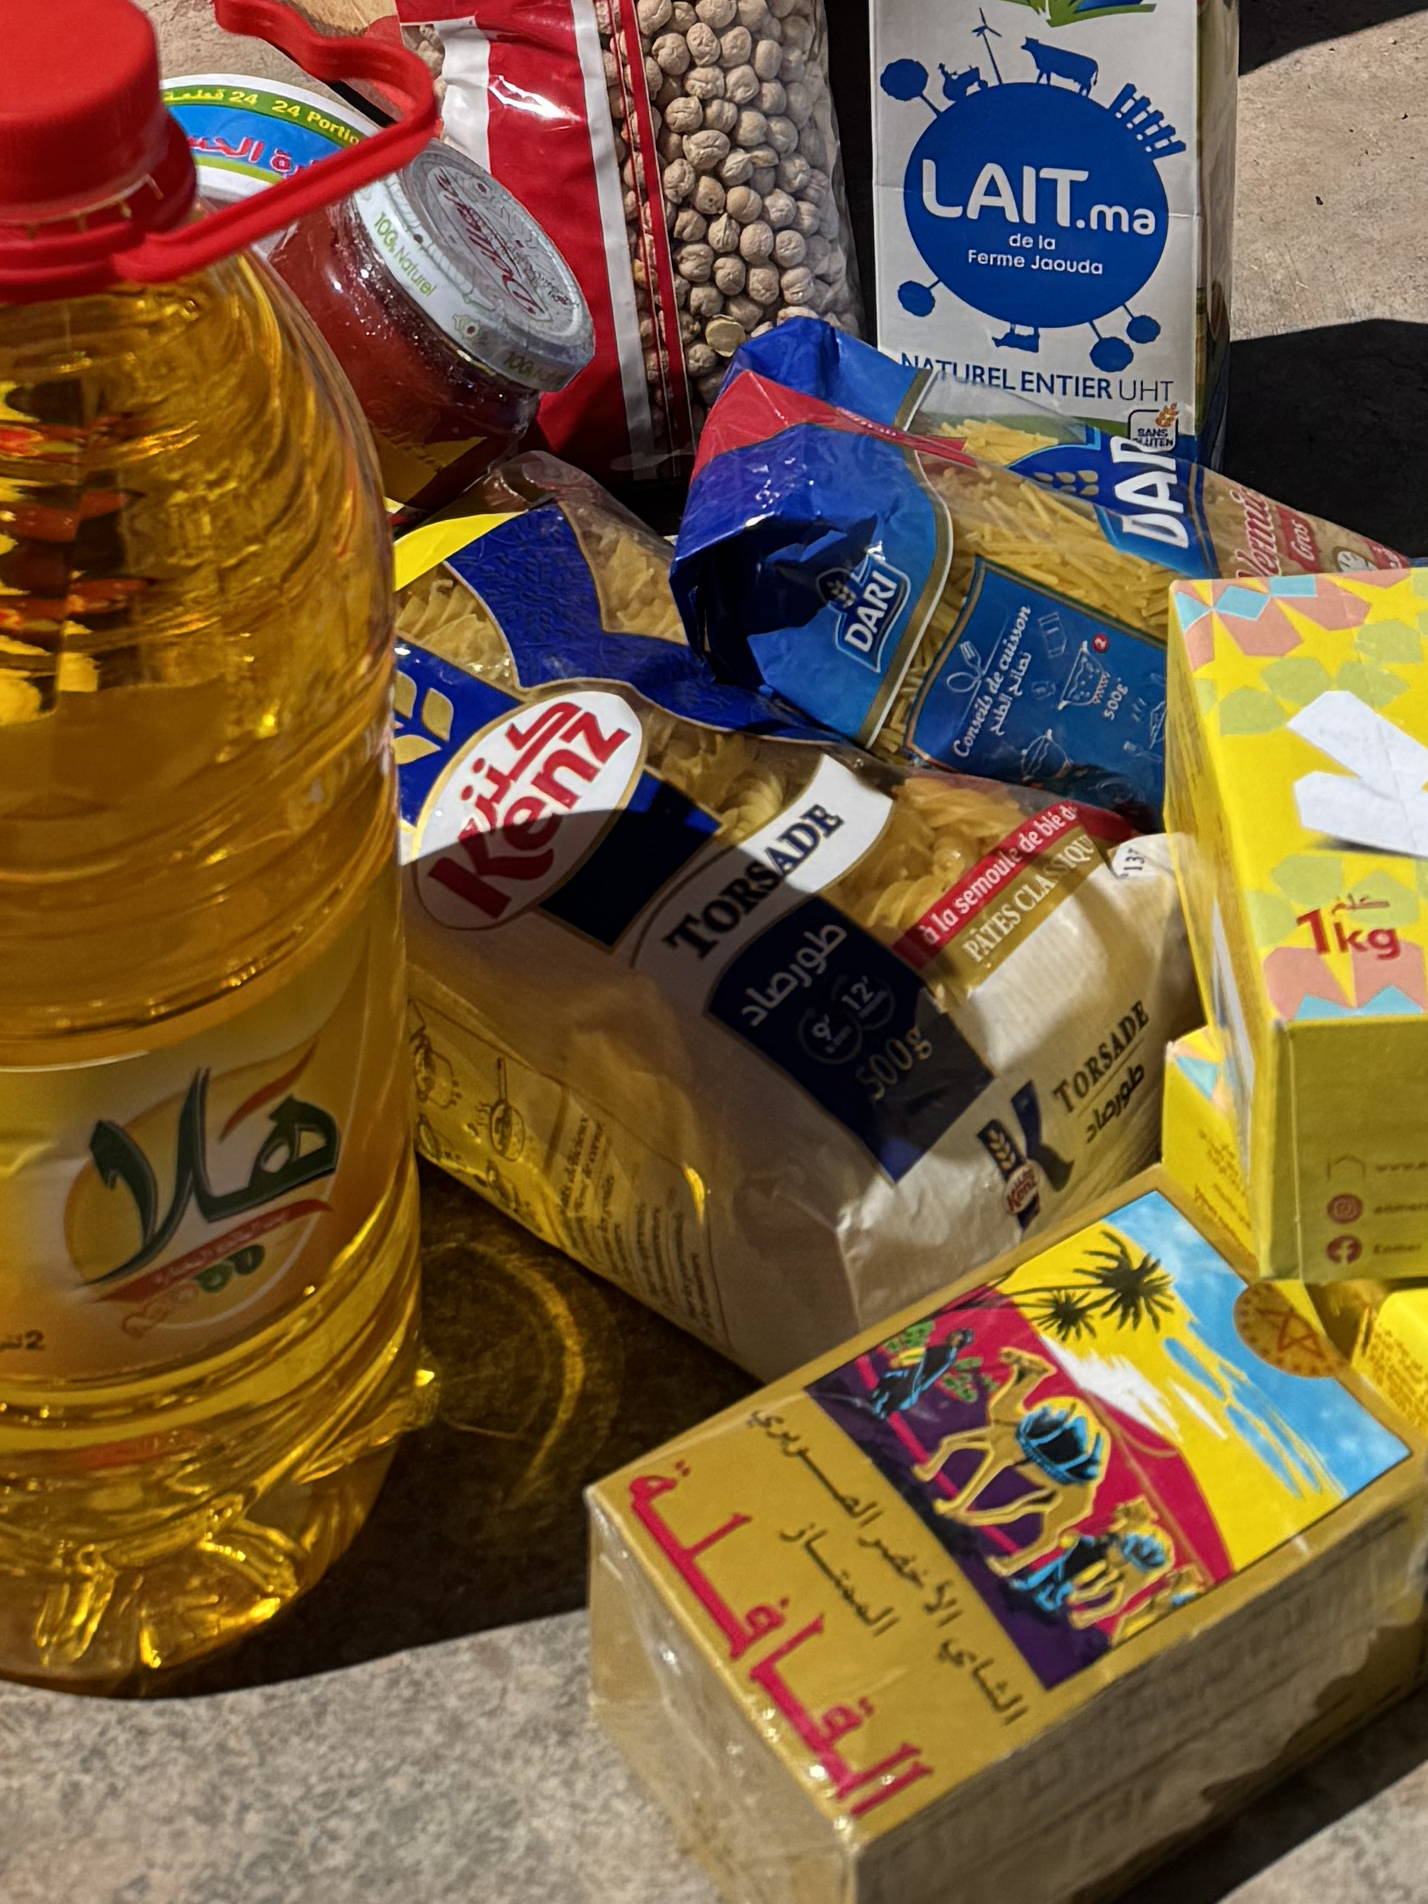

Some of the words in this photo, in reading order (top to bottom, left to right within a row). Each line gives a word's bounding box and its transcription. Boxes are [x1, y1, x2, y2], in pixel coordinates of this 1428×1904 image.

[229, 91, 258, 105] 24
[272, 100, 300, 117] 24
[307, 111, 360, 145] Portio
[922, 159, 1156, 235] LAIT.ma
[391, 246, 438, 298] Naturel
[968, 250, 1025, 269] Ferme
[1031, 253, 1104, 275] Jaouda
[1009, 234, 1033, 248] de
[1038, 235, 1056, 250] la
[1021, 371, 1112, 399] ENTIER
[1119, 379, 1174, 402] UHT
[1138, 428, 1168, 441] SANS
[1289, 519, 1315, 562] Gros
[844, 568, 897, 654] DARI
[1093, 636, 1107, 649] 2
[950, 691, 993, 758] Conseils
[981, 668, 1005, 694] de
[993, 604, 1034, 671] cuisson
[1003, 650, 1038, 696] نصائح
[1101, 681, 1129, 721] 500g
[985, 693, 1018, 736] الطبخ
[459, 700, 583, 837] كنز
[428, 711, 631, 919] Kenz
[664, 802, 844, 961] TORSADE
[916, 921, 940, 946] à
[930, 903, 959, 933] la
[954, 846, 1025, 919] semoule
[1013, 826, 1043, 855] de
[1033, 807, 1066, 839] blé
[957, 898, 1025, 963] PÂTES
[1010, 831, 1099, 915] CLASSIQU
[1296, 907, 1402, 960] 1kg
[740, 922, 848, 1028] طورصاد
[856, 1023, 933, 1101] 500g
[1052, 1000, 1150, 1114] TORSADE
[1085, 1064, 1145, 1144] طورصاد
[73, 1067, 340, 1290] هلا
[24, 1330, 45, 1351] 2
[778, 1521, 899, 1637] الممتاز
[860, 1533, 963, 1629] الأخضر
[628, 1458, 934, 1819] القافلة
[939, 1637, 1030, 1725] الشاي
